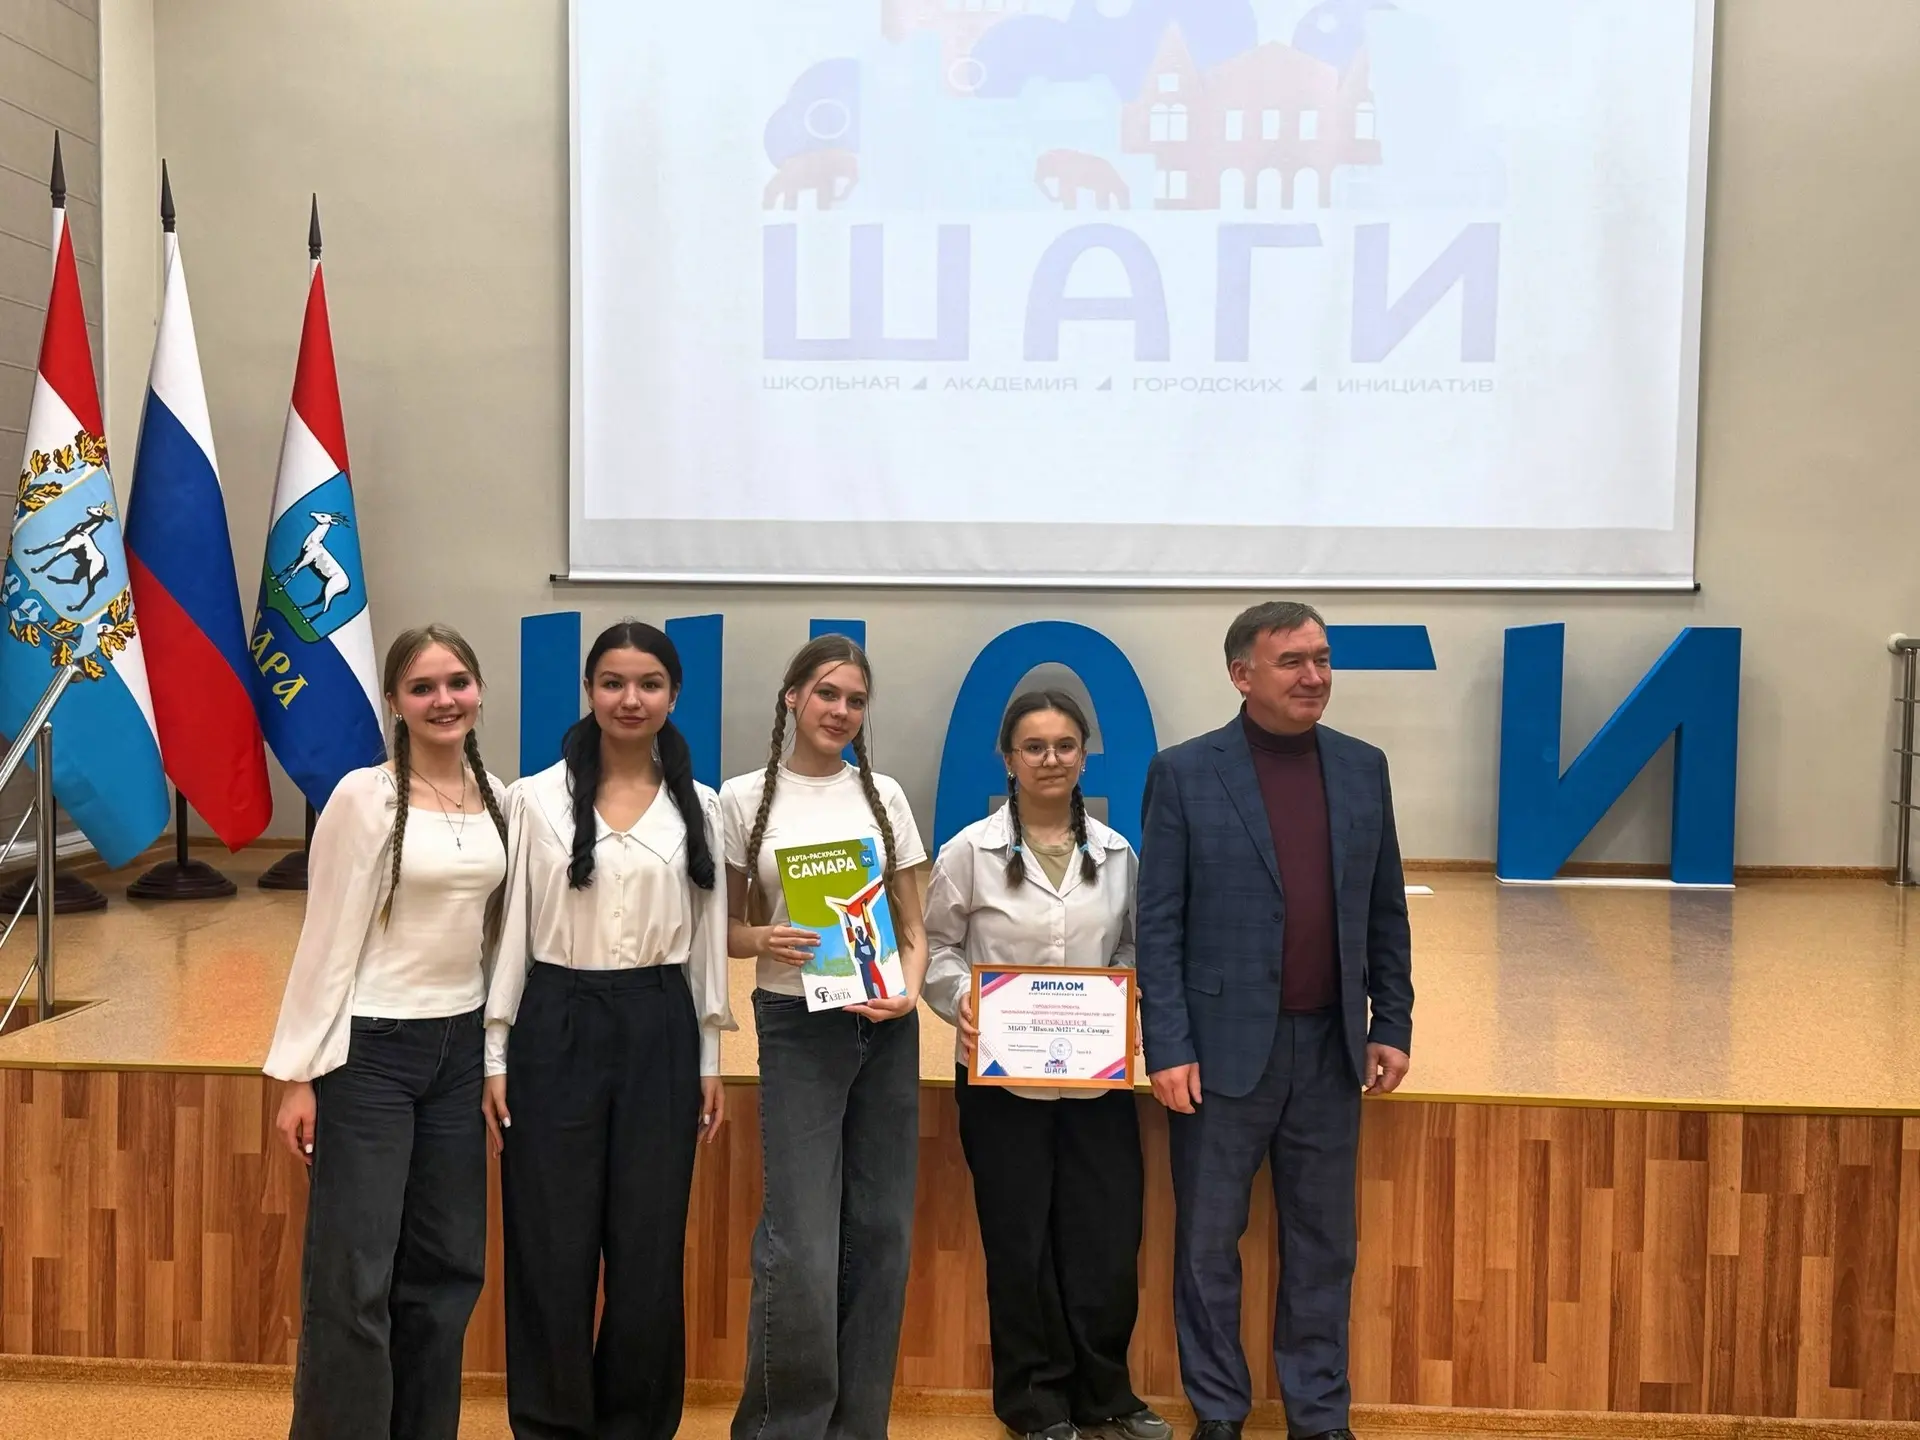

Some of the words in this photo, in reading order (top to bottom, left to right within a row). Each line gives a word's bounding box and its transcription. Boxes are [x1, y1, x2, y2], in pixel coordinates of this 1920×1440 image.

[762, 222, 1501, 363] ШАГИ
[763, 376, 901, 391] ШКОЛЬНАЯ
[943, 376, 1078, 392] АКАДЕМИЯ
[1133, 377, 1283, 393] ГОРОДСКИХ
[1337, 378, 1494, 394] ИНИЦИАТИВ
[251, 609, 308, 710] АРА
[786, 849, 847, 863] КАРТА-РАСКРАСКА
[788, 857, 857, 879] САМАРА
[1031, 980, 1084, 991] ДИПЛОМ
[1031, 1018, 1087, 1026] НАГРАЖДАЕТСЯ
